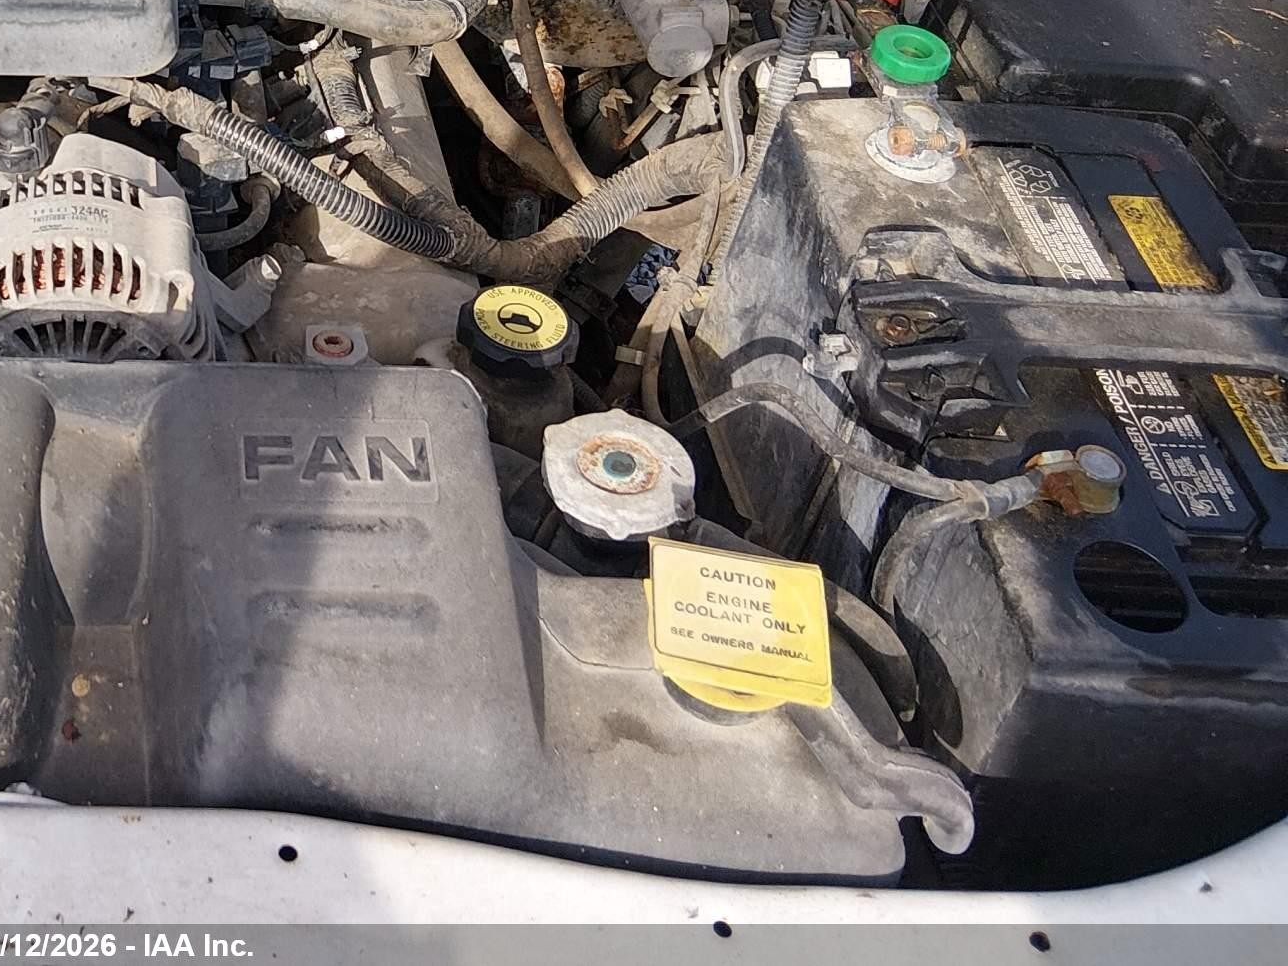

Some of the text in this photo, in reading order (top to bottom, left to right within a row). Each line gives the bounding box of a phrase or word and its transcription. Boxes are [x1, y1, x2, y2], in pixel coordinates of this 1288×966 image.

[486, 287, 558, 311] USE APPROVED
[492, 333, 544, 349] STEERING
[546, 323, 565, 344] FLUID
[1095, 369, 1129, 413] POISON
[242, 435, 431, 482] FAN
[1124, 426, 1165, 480] DANGER
[699, 566, 777, 590] CAUTION
[674, 601, 807, 635] COOLANT ONLY
[706, 591, 772, 613] ENGINE
[670, 626, 812, 662] SEE OWNERS MANUAL
